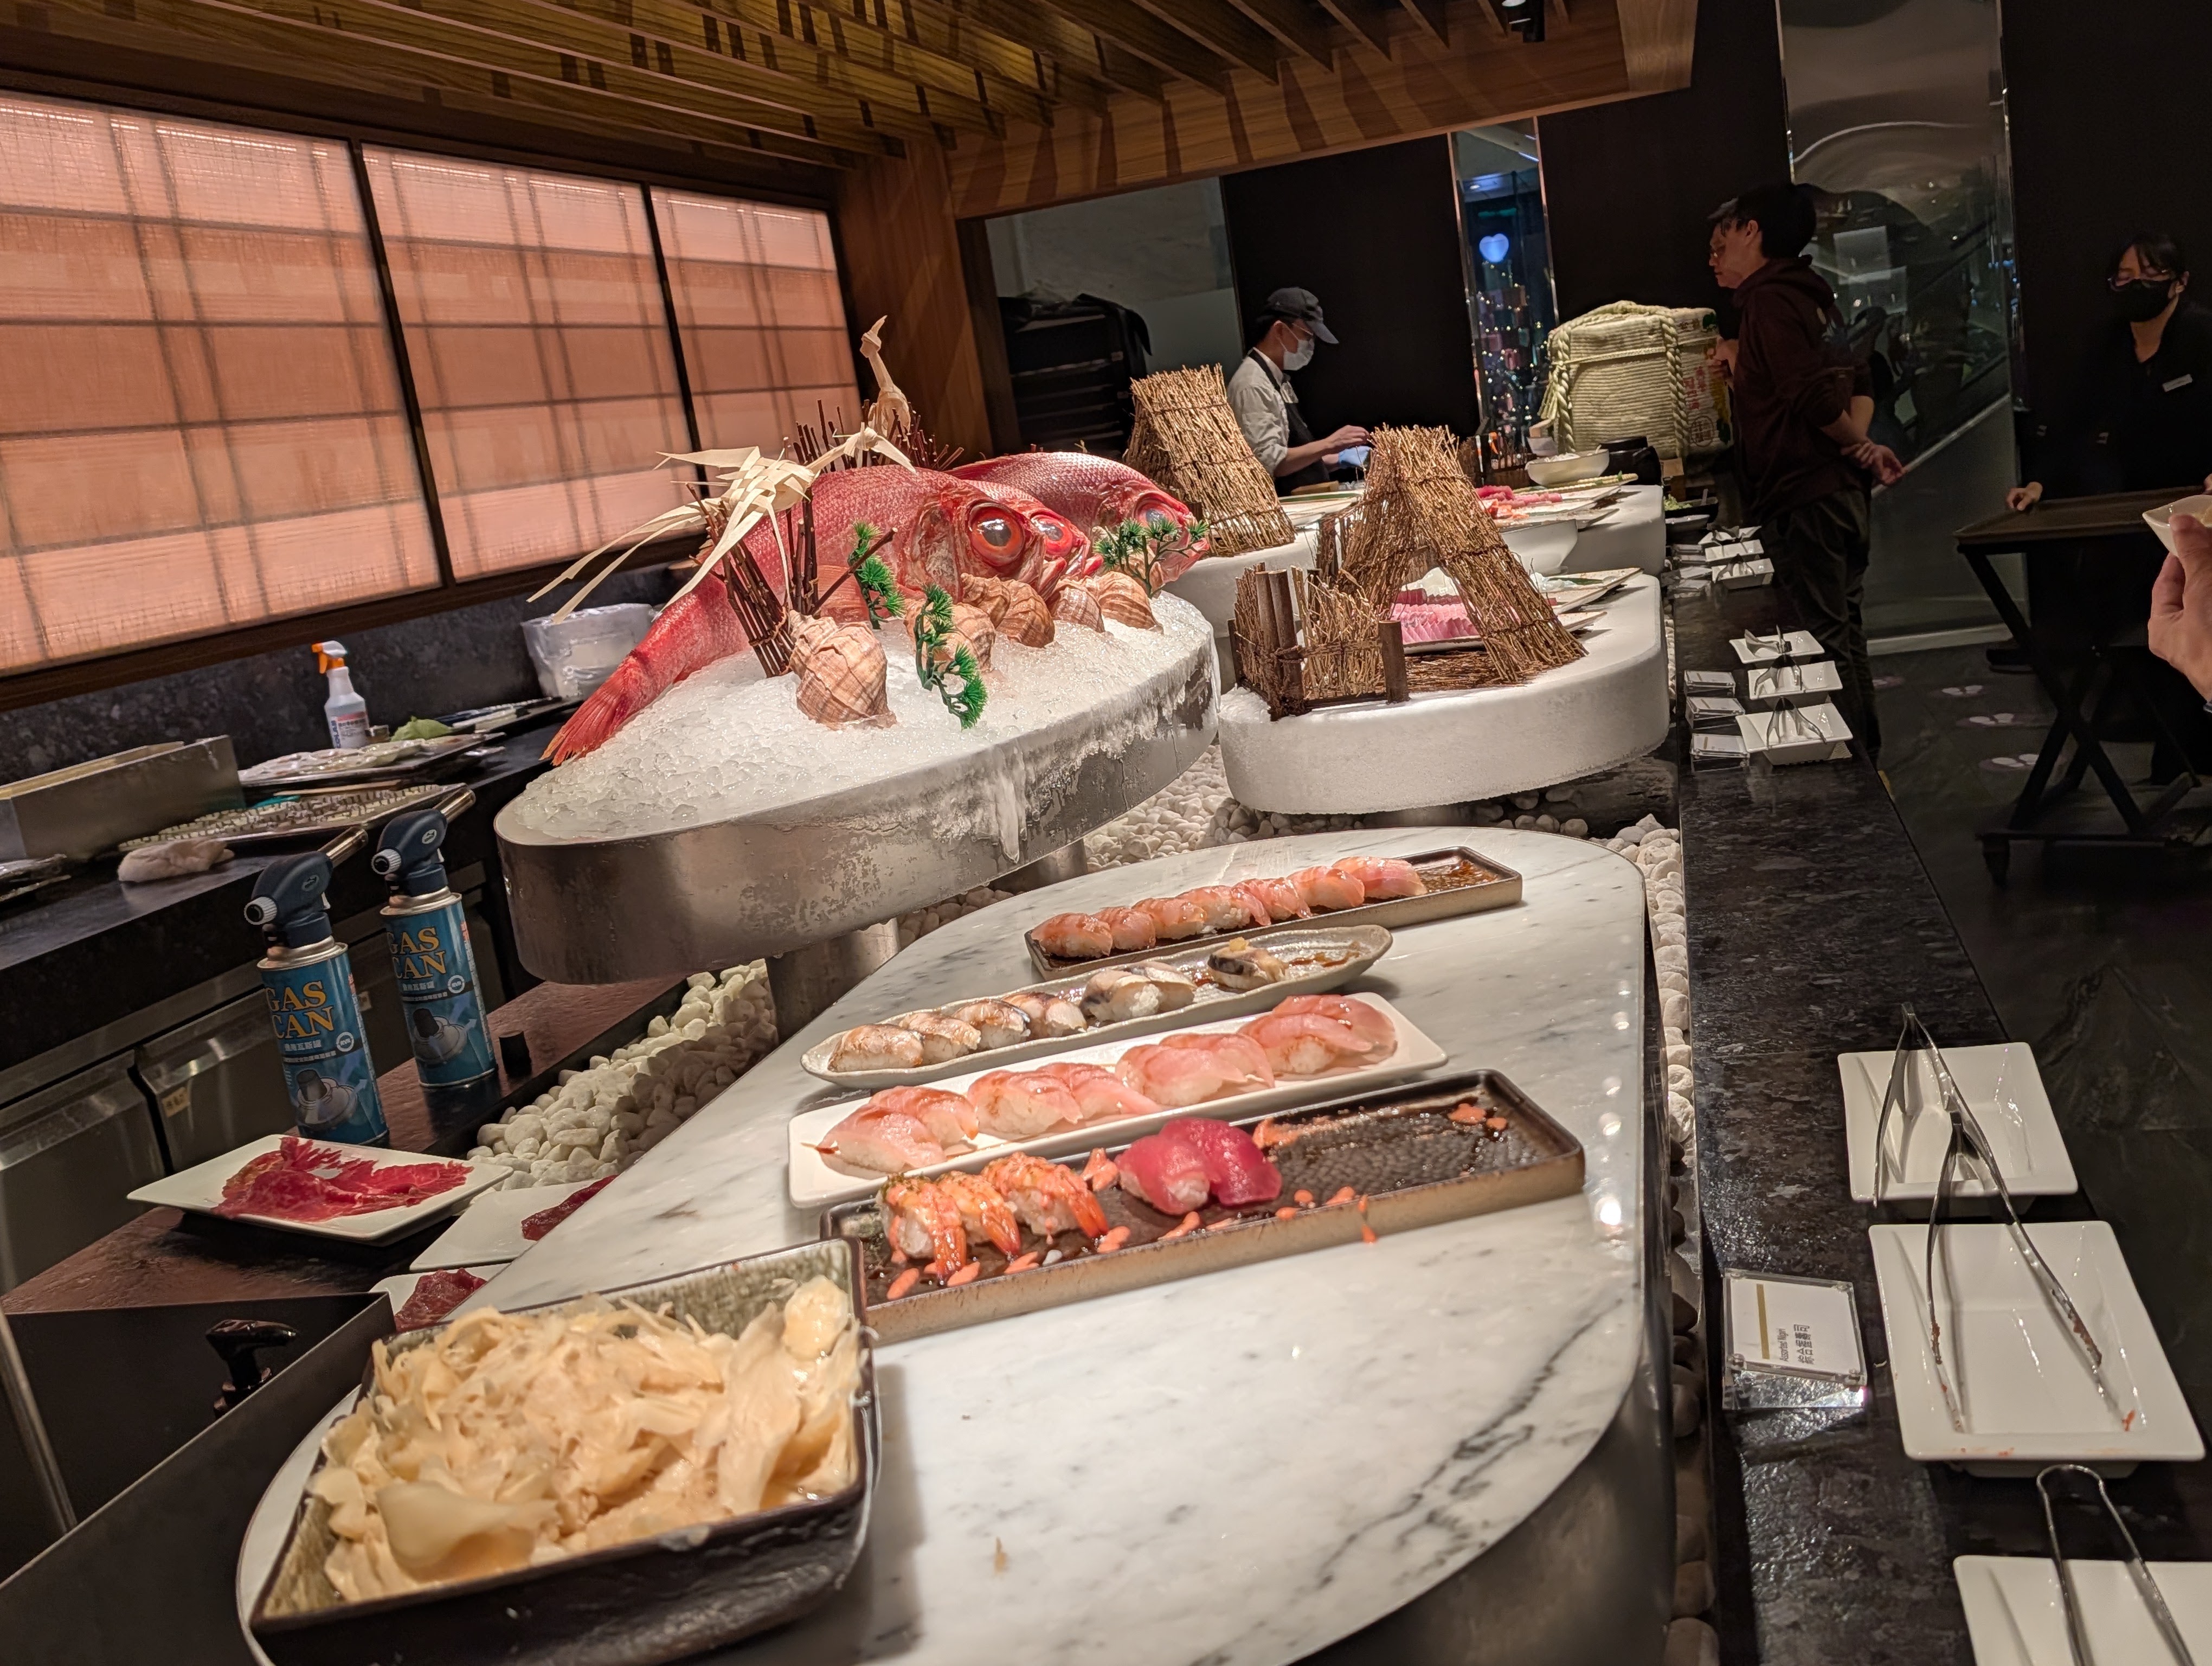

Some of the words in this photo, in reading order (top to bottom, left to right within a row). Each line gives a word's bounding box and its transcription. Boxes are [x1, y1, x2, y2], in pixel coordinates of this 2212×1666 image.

[387, 927, 439, 954] GAS
[392, 951, 446, 979] CAN
[266, 981, 326, 1011] GAS
[273, 1006, 334, 1039] CAN
